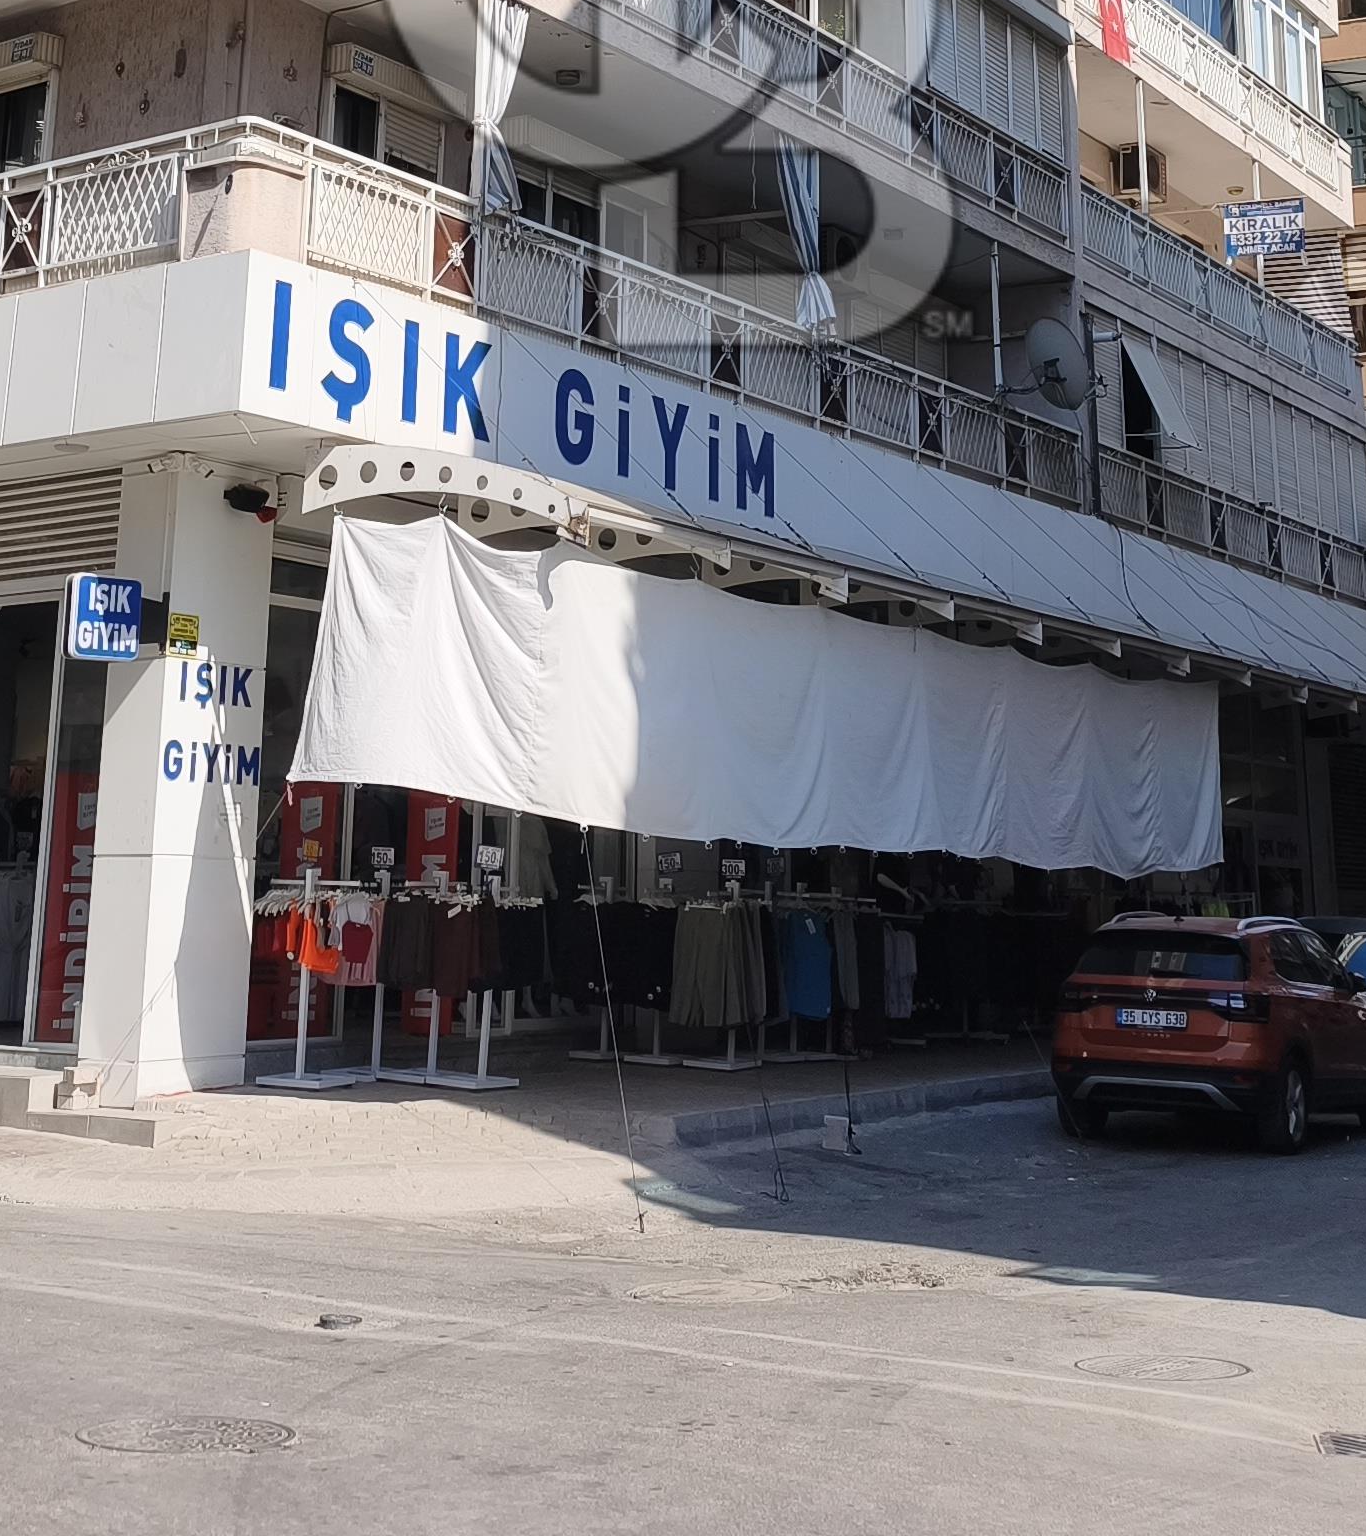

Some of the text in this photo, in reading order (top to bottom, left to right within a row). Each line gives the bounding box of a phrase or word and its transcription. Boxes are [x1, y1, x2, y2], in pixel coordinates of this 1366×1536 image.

[1237, 242, 1296, 256] AHMET ACAR
[1264, 232, 1282, 244] 22
[1283, 230, 1301, 242] 72
[268, 279, 493, 444] IŞIK
[88, 581, 133, 615] IŞIK
[179, 660, 254, 710] IŞIK
[1122, 1010, 1136, 1024] 35
